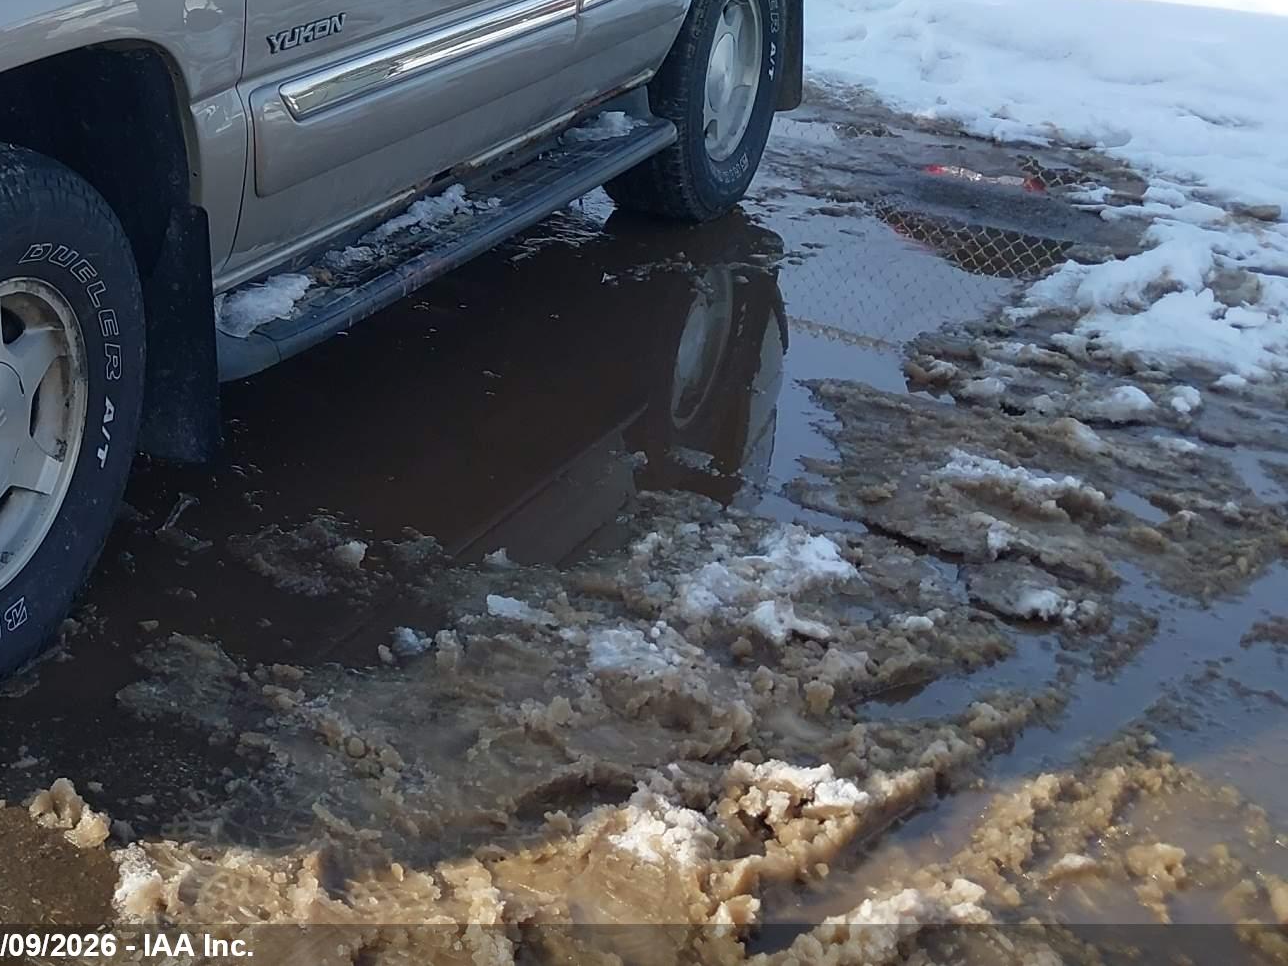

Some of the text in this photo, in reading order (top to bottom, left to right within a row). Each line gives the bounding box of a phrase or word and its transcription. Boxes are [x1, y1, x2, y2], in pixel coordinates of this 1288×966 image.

[266, 12, 347, 54] YUKON
[18, 242, 123, 469] DUELER A/T
